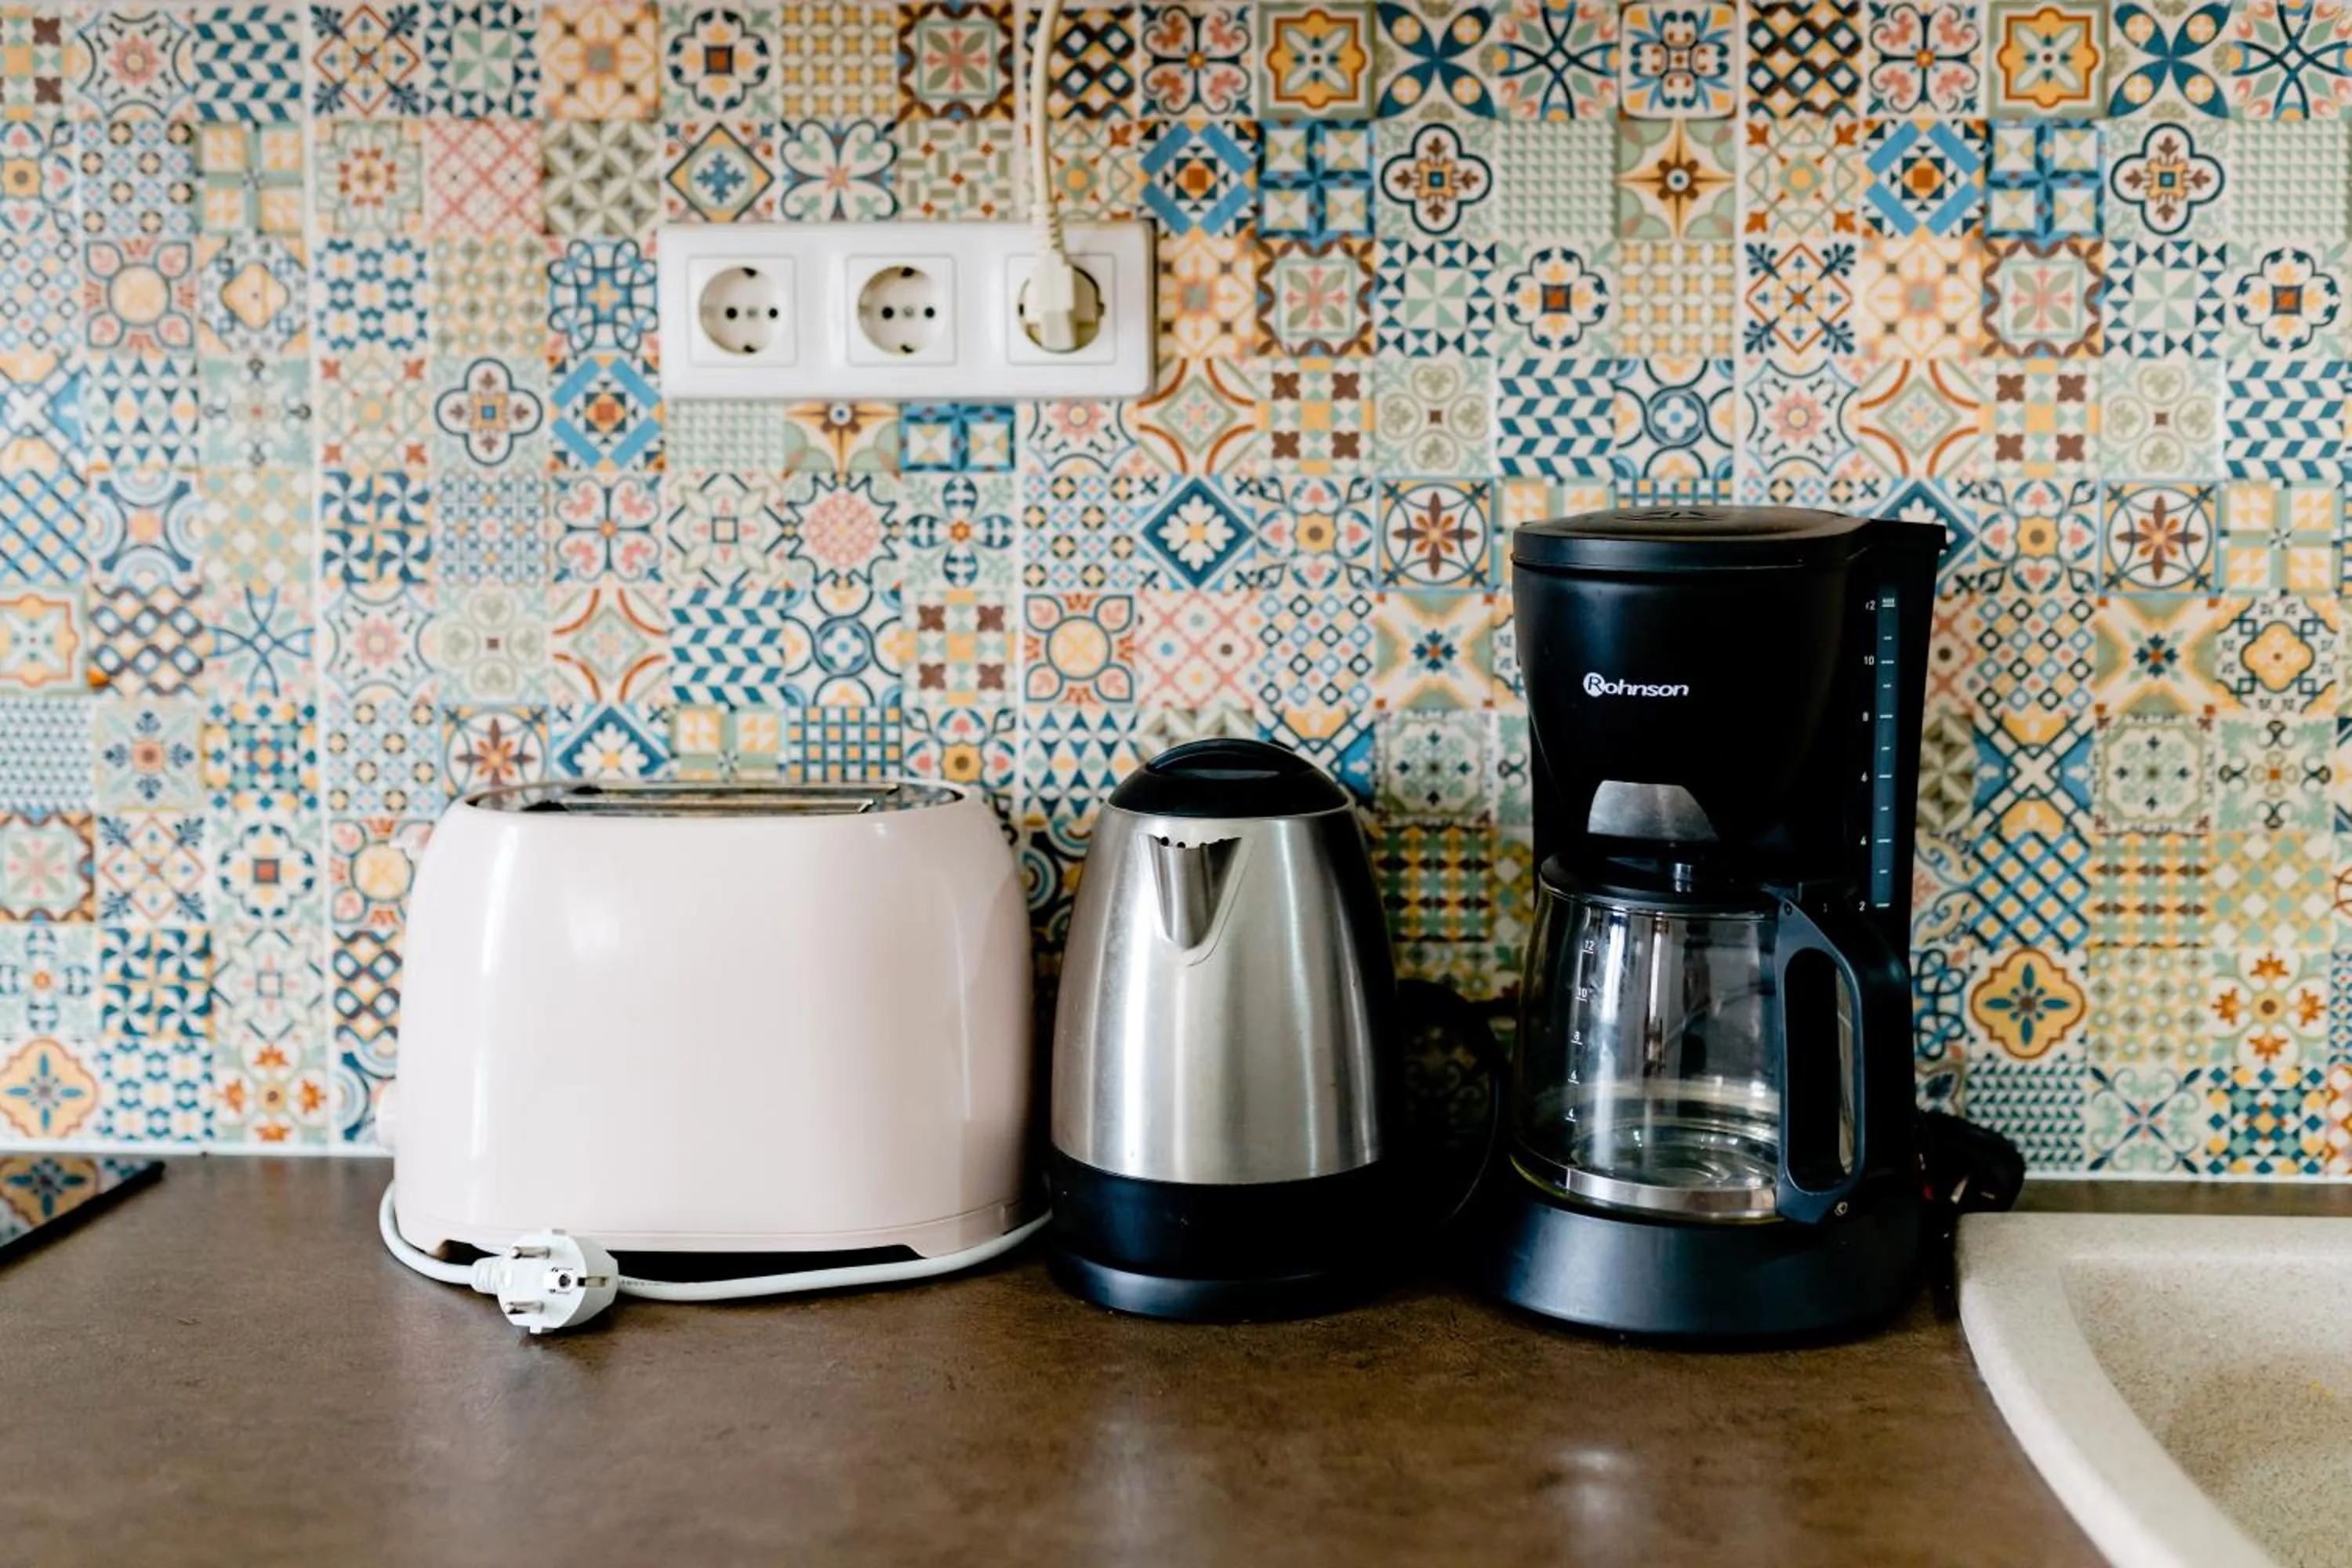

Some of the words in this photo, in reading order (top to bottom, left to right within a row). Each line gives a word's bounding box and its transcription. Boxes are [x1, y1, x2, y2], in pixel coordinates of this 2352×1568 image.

[1864, 655, 1875, 666] 10
[1583, 672, 1690, 698] Rohnson
[1859, 900, 1866, 912] 2
[1584, 940, 1595, 950] 12
[1577, 988, 1588, 998] 10
